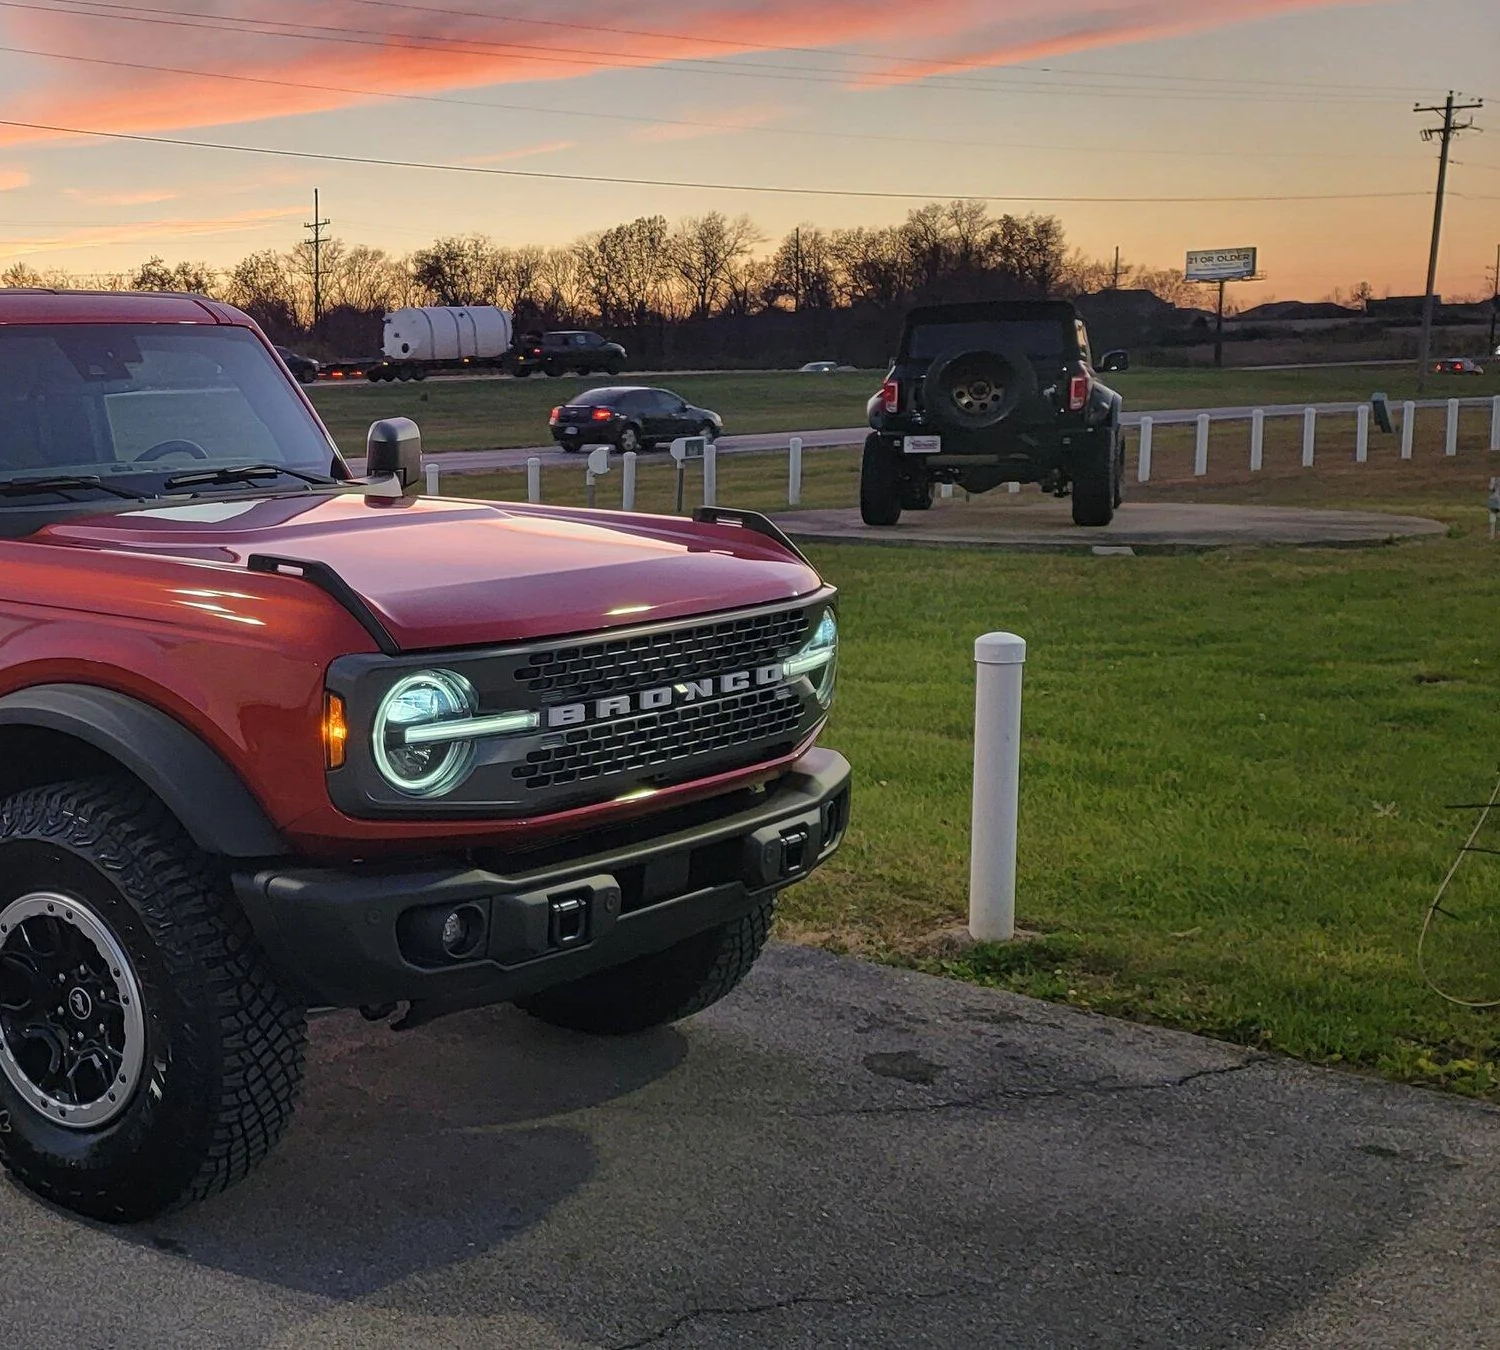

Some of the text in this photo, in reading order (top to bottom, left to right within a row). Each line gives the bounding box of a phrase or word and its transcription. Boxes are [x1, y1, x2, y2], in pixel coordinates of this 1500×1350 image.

[1200, 256, 1214, 264] OR
[1217, 254, 1250, 262] OLDER
[548, 664, 783, 727] BRONCO
